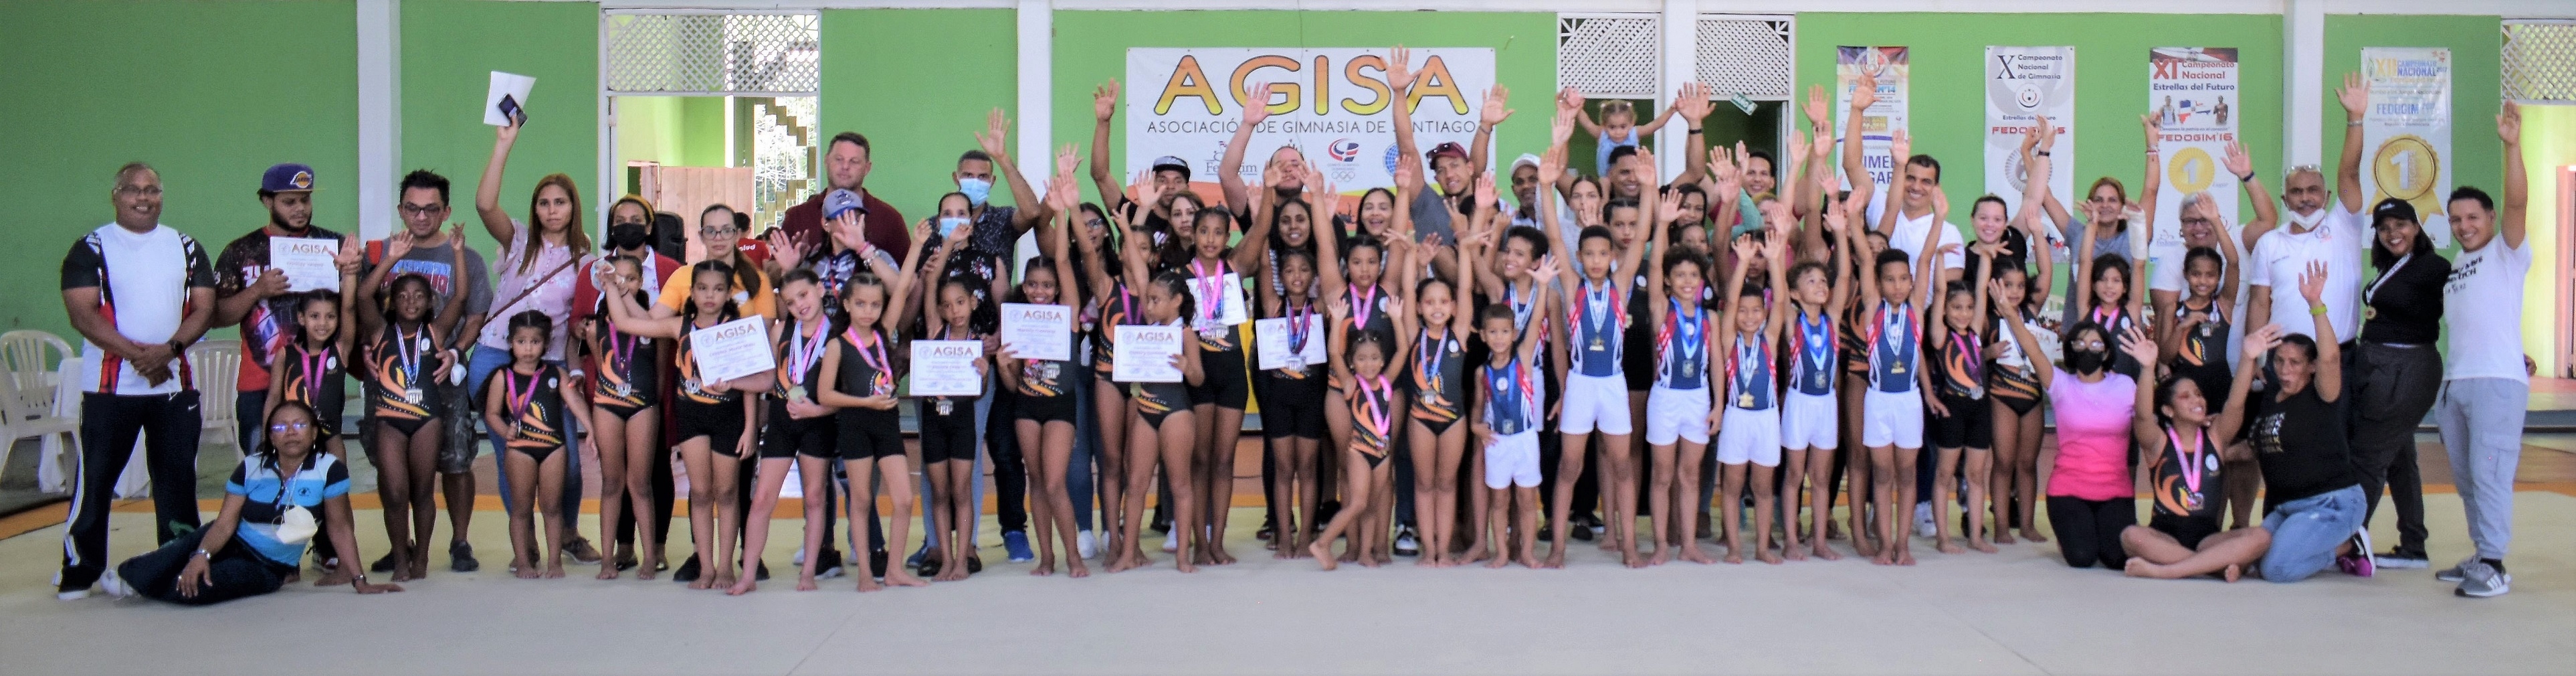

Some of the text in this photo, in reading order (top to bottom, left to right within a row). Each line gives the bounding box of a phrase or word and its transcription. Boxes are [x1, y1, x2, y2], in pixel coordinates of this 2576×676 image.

[2017, 54, 2063, 62] Campeonato
[1997, 55, 2016, 79] X
[2153, 59, 2178, 80] XI
[2182, 61, 2235, 69] Campeonato
[2375, 58, 2397, 76] XII
[2182, 71, 2225, 79] Nacional
[2397, 67, 2437, 76] NACIONAL
[1154, 55, 1470, 116] AGISA
[2376, 103, 2419, 114] FEDOGIM
[1147, 118, 1476, 133] ASOCIACIÓ DE GIMNASIA DE NTIAGO
[1205, 161, 1258, 174] Feim
[2183, 158, 2197, 185] 1
[2390, 150, 2409, 190] 1
[292, 244, 330, 254] AGISA
[1023, 310, 1062, 322] AGISA
[716, 323, 757, 342] AGISA
[1136, 332, 1174, 342] AGISA
[933, 346, 974, 356] AGISA
